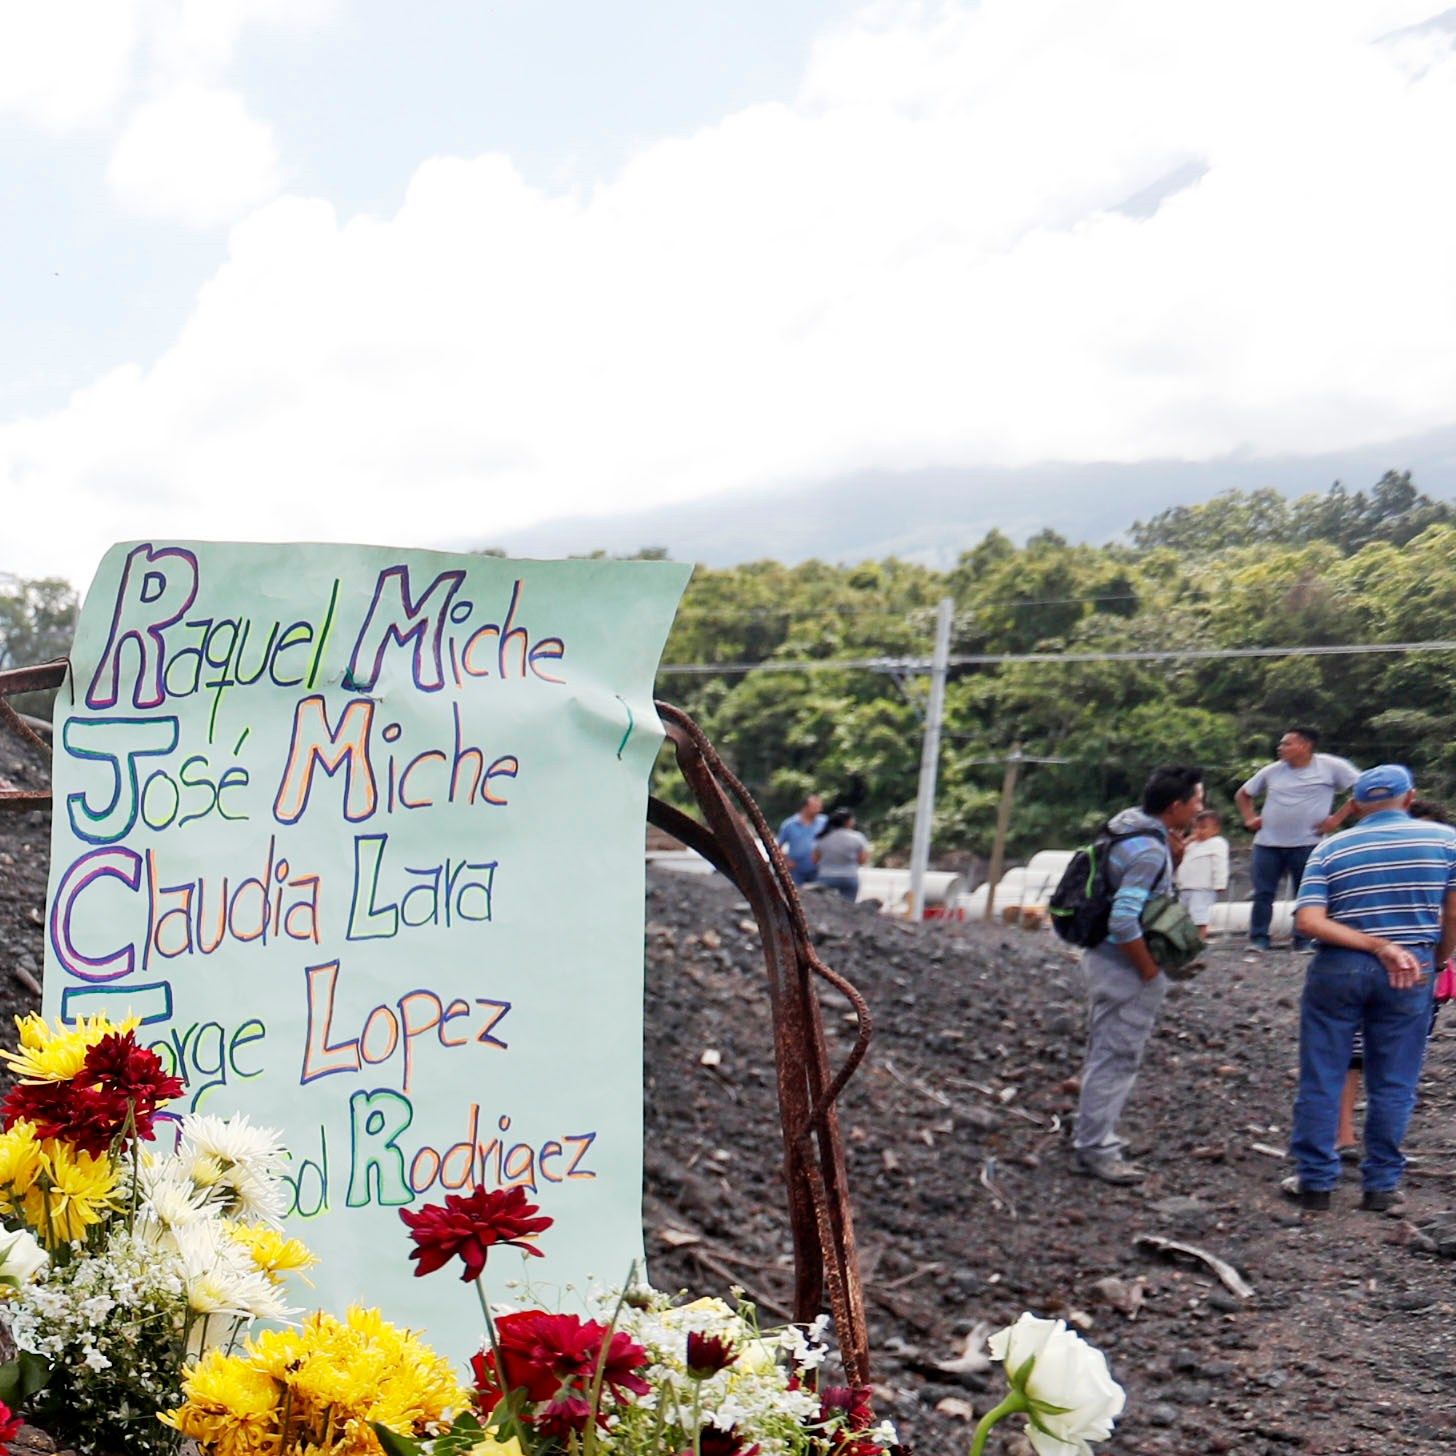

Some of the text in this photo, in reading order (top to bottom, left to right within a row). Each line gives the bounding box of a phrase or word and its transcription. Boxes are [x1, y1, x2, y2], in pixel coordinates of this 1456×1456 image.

[85, 543, 568, 744] Raquel Miche
[62, 695, 520, 845] José Miche
[51, 833, 499, 983] Claudia Lara
[299, 958, 513, 1093] Lopez
[346, 1089, 597, 1208] Rodrigez
